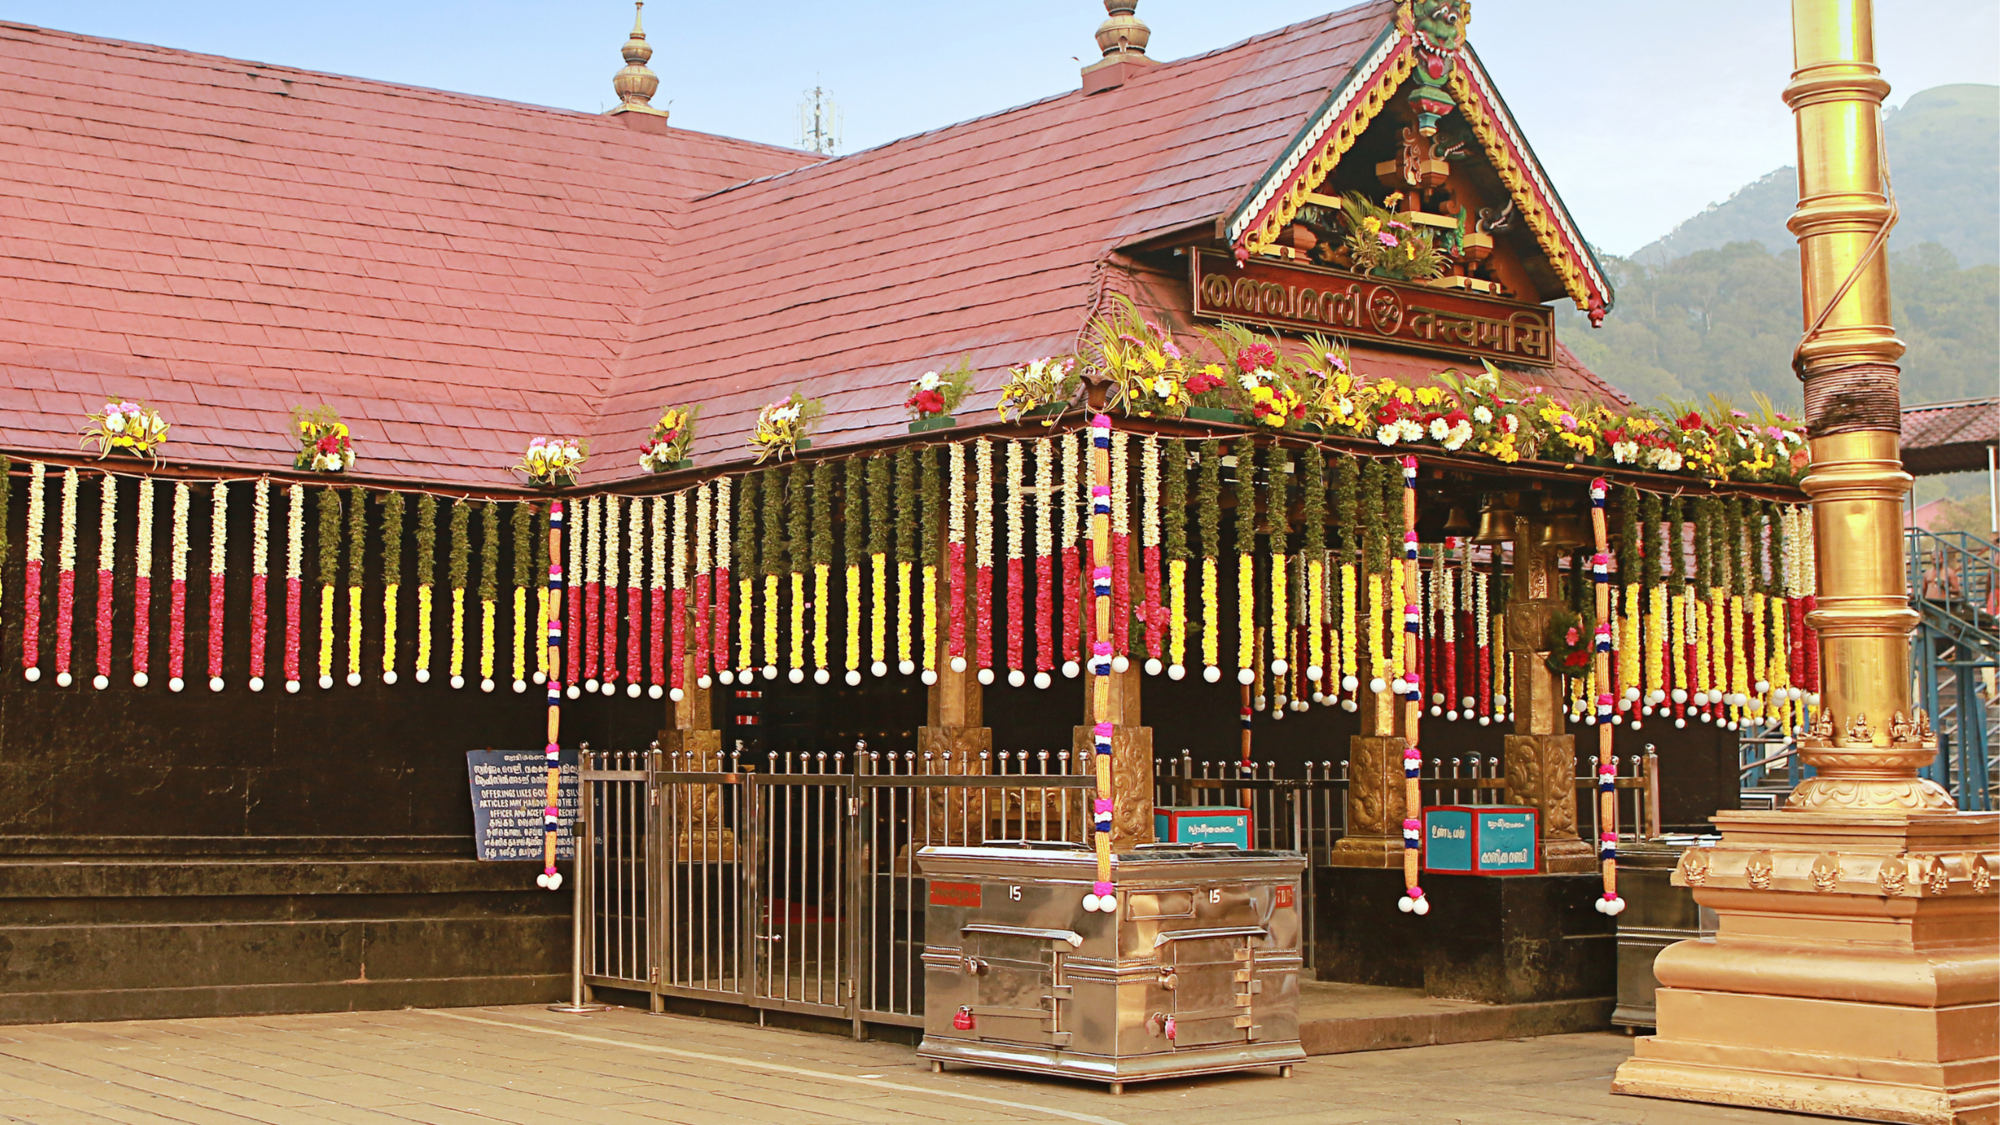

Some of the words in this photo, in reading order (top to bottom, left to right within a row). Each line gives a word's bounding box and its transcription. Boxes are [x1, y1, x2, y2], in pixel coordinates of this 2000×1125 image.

[481, 789, 517, 799] OFFERINGS
[532, 789, 547, 797] GOL
[479, 799, 508, 808] ARTICLES
[1009, 885, 1022, 902] 15
[1209, 888, 1220, 903] 15
